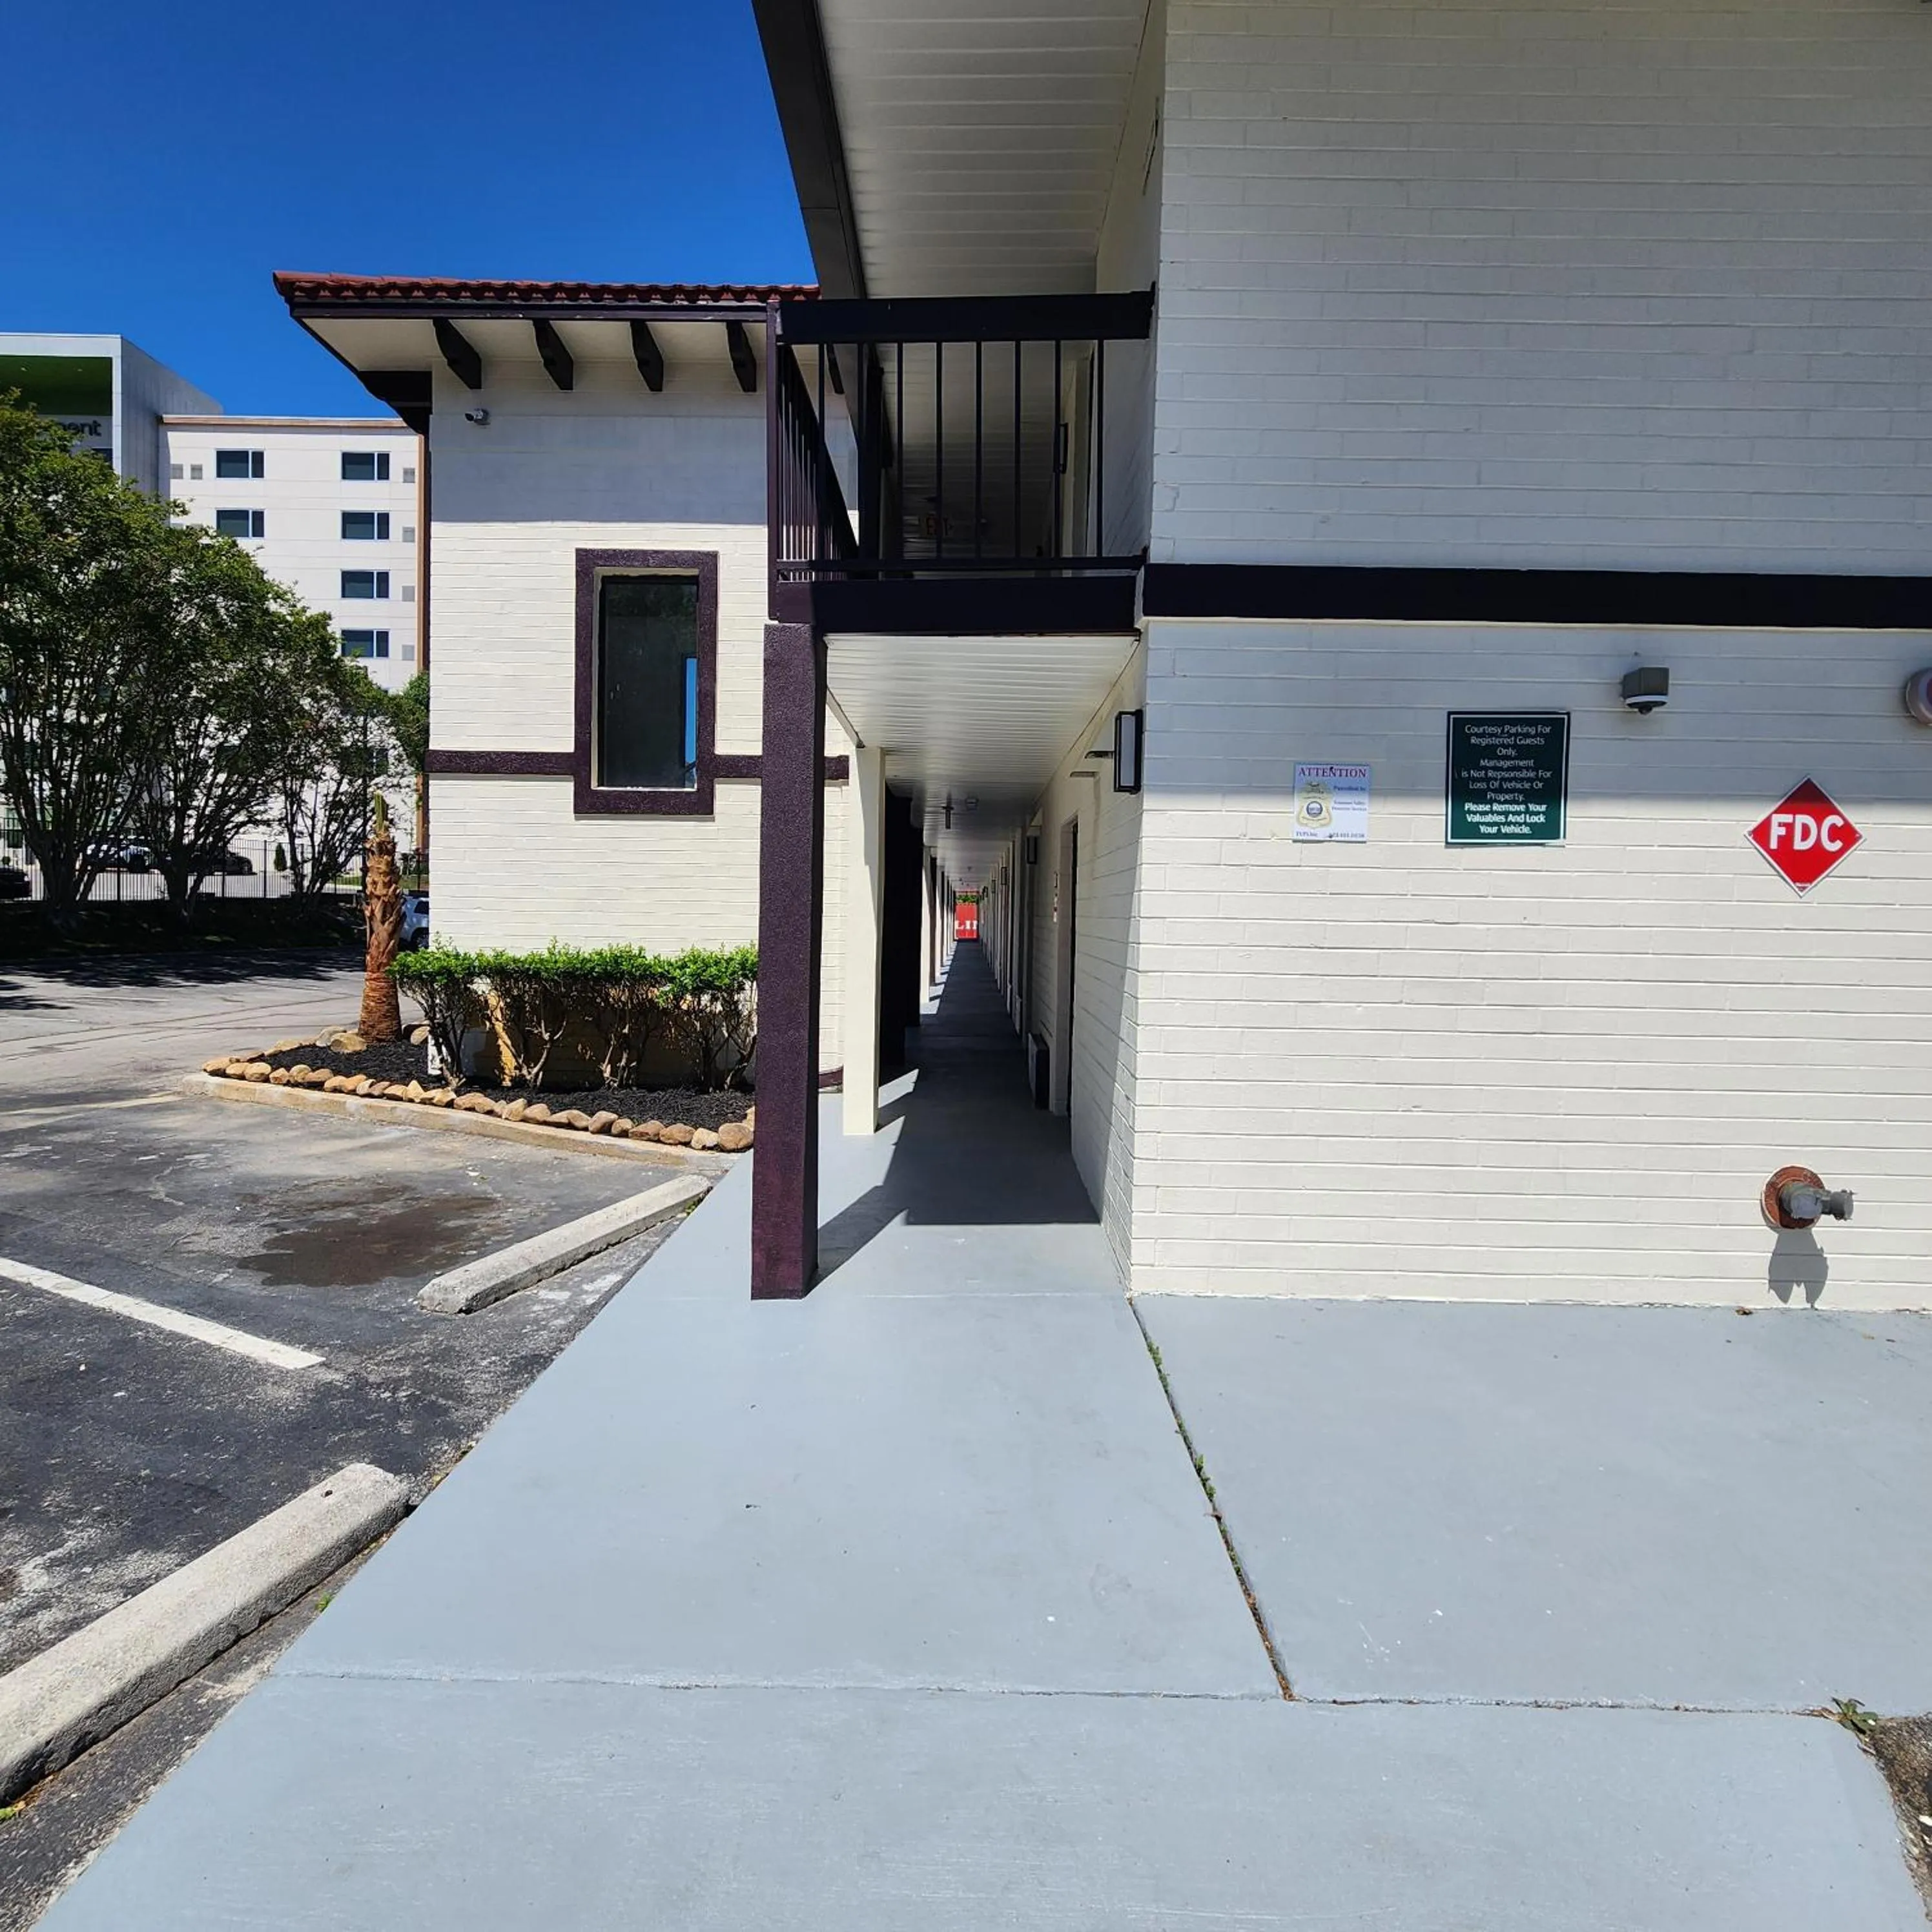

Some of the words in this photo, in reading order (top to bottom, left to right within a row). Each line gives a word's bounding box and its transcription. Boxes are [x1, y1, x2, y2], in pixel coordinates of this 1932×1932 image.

[57, 420, 101, 437] ent
[1465, 724, 1503, 735] Courtesy
[1504, 724, 1536, 735] Parking
[1537, 724, 1552, 734] For
[1470, 736, 1514, 746] Registered
[1517, 736, 1545, 745] Guests
[1496, 747, 1517, 757] Only.
[1479, 759, 1534, 768] Management
[1299, 766, 1366, 777] ATTENTION
[1470, 770, 1486, 778] Not
[1538, 770, 1552, 778] For
[1502, 781, 1531, 789] Vehicle
[1487, 792, 1525, 801] Property.
[1464, 802, 1491, 811] Please
[1492, 803, 1526, 811] Remove
[1527, 803, 1547, 811] Your
[1466, 814, 1506, 823] Valuables
[1507, 814, 1525, 823] And
[1526, 814, 1546, 823] Lock
[1479, 825, 1499, 834] Your
[1501, 825, 1532, 834] Vehicle.
[1769, 814, 1845, 852] FDC
